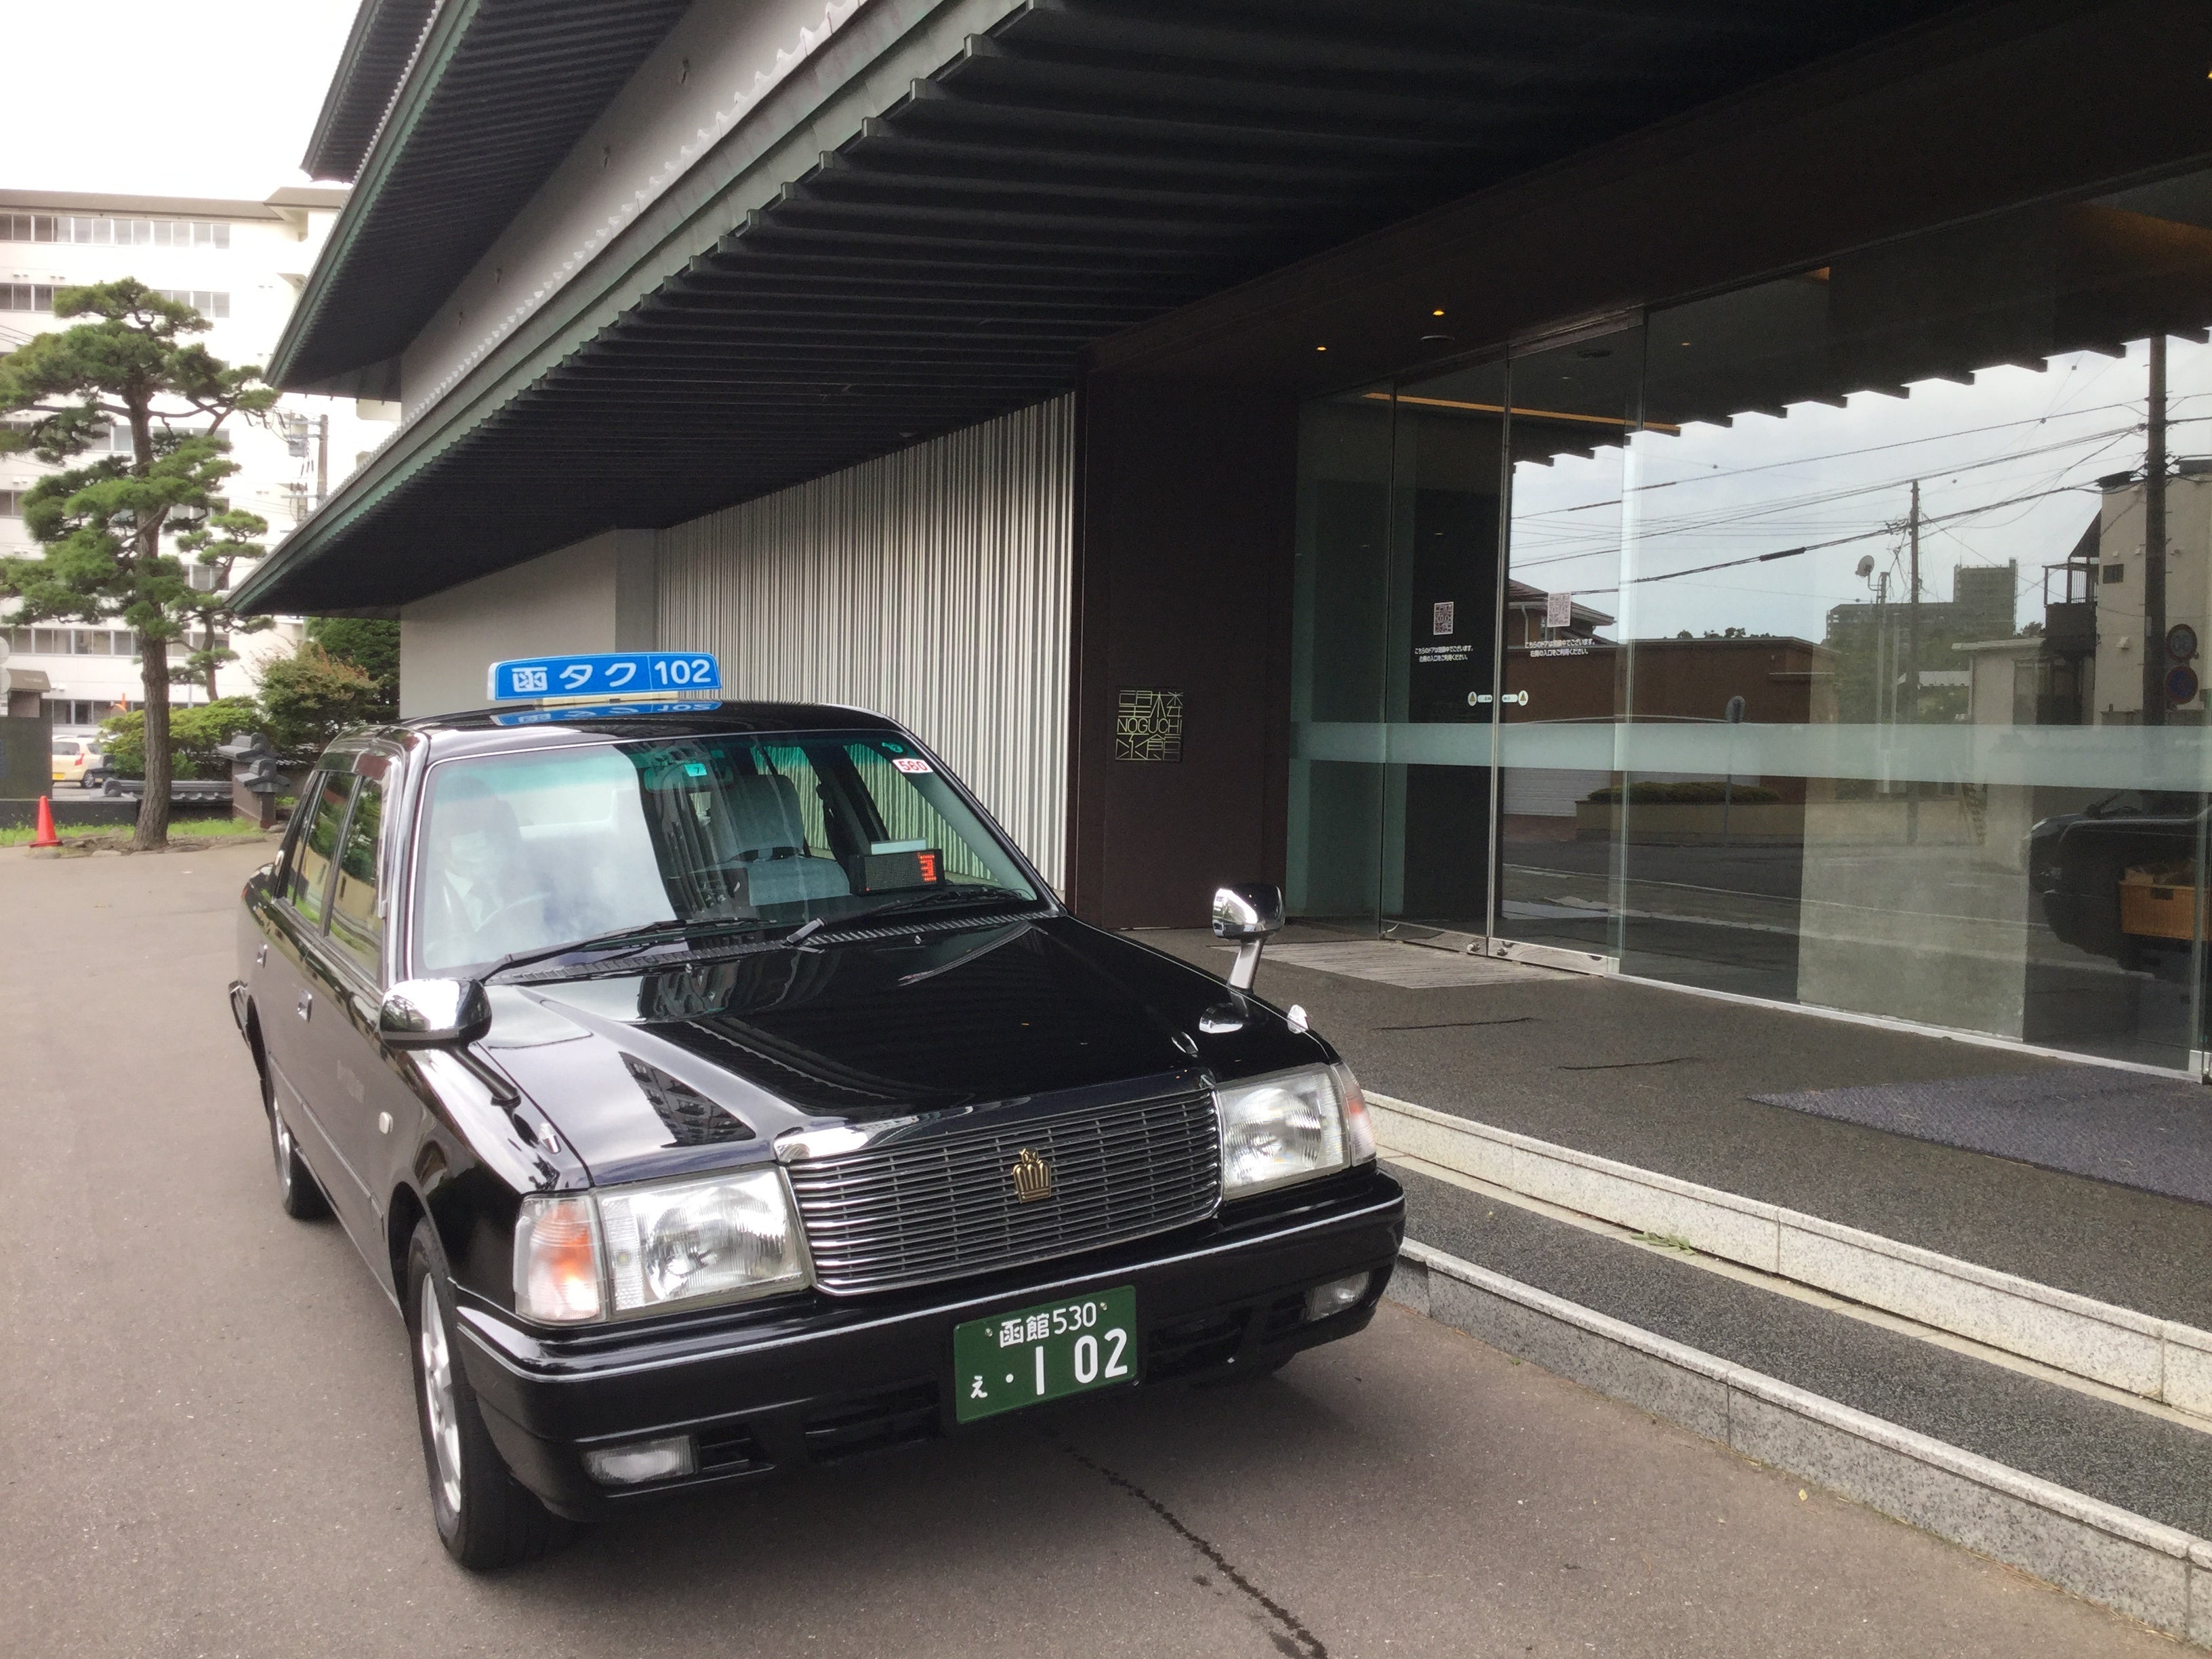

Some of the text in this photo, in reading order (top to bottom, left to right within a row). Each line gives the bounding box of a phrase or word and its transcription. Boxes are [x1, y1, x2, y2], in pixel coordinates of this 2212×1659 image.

[512, 659, 712, 693] 函タク 102
[1117, 718, 1183, 734] NOGUCHI
